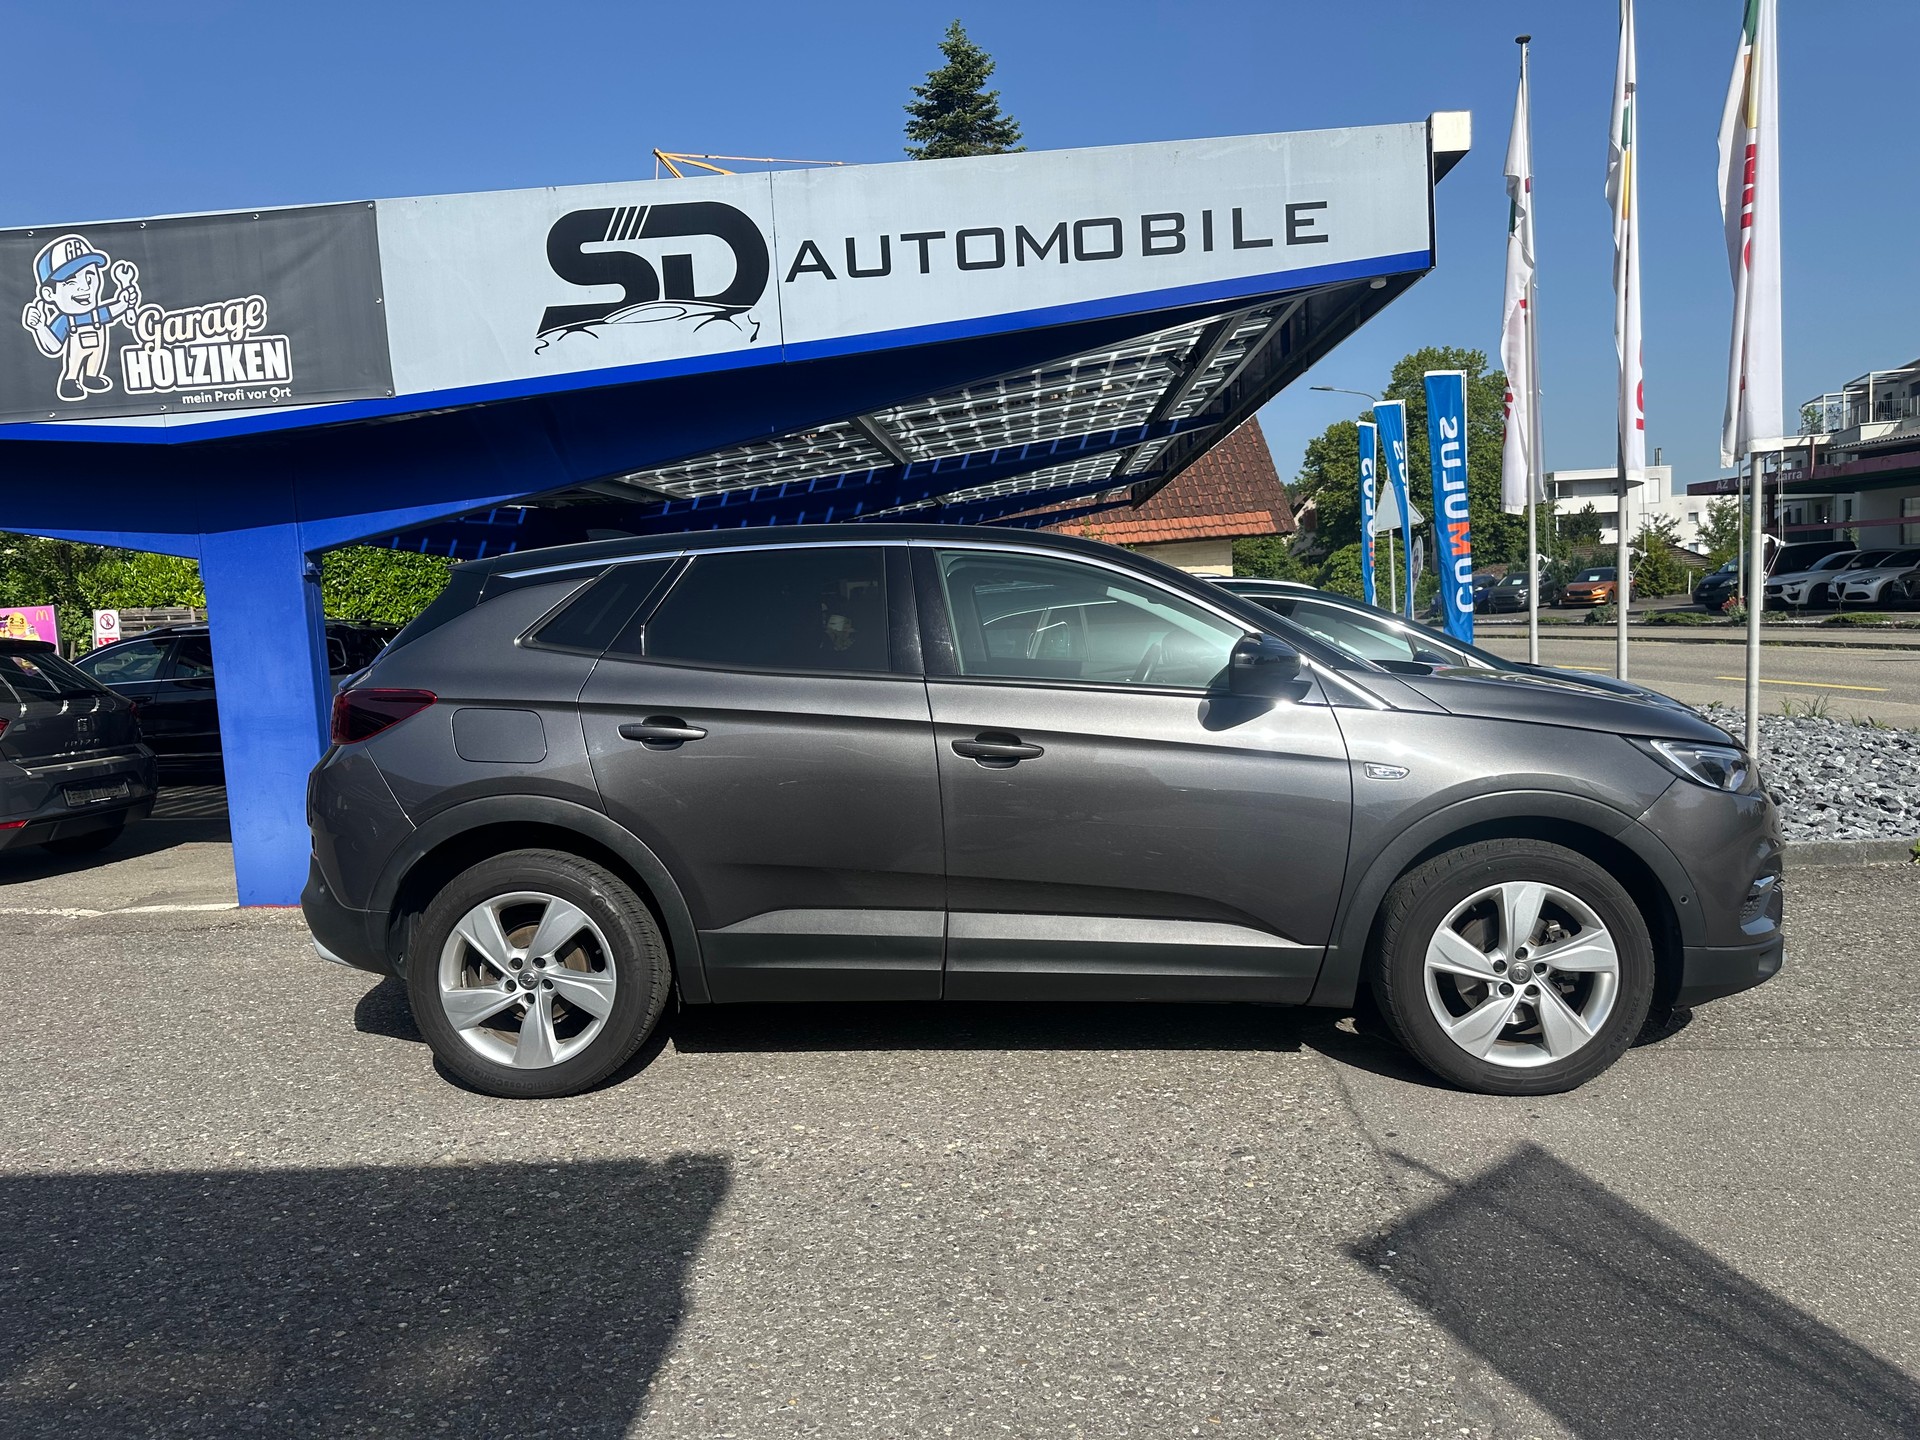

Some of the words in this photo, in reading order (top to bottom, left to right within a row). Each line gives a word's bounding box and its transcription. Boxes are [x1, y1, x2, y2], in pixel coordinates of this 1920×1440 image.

[65, 241, 84, 262] GB
[536, 201, 770, 337] SD
[784, 200, 1329, 283] AUTOMOBILE
[137, 300, 263, 355] Garage
[126, 341, 287, 389] HOLZIKEN
[182, 393, 213, 404] mein
[215, 388, 245, 402] Profi
[247, 390, 267, 399] vor
[269, 387, 292, 400] Ort
[1716, 479, 1729, 490] AZ
[1734, 474, 1768, 488] are
[1775, 470, 1803, 482] Zarra
